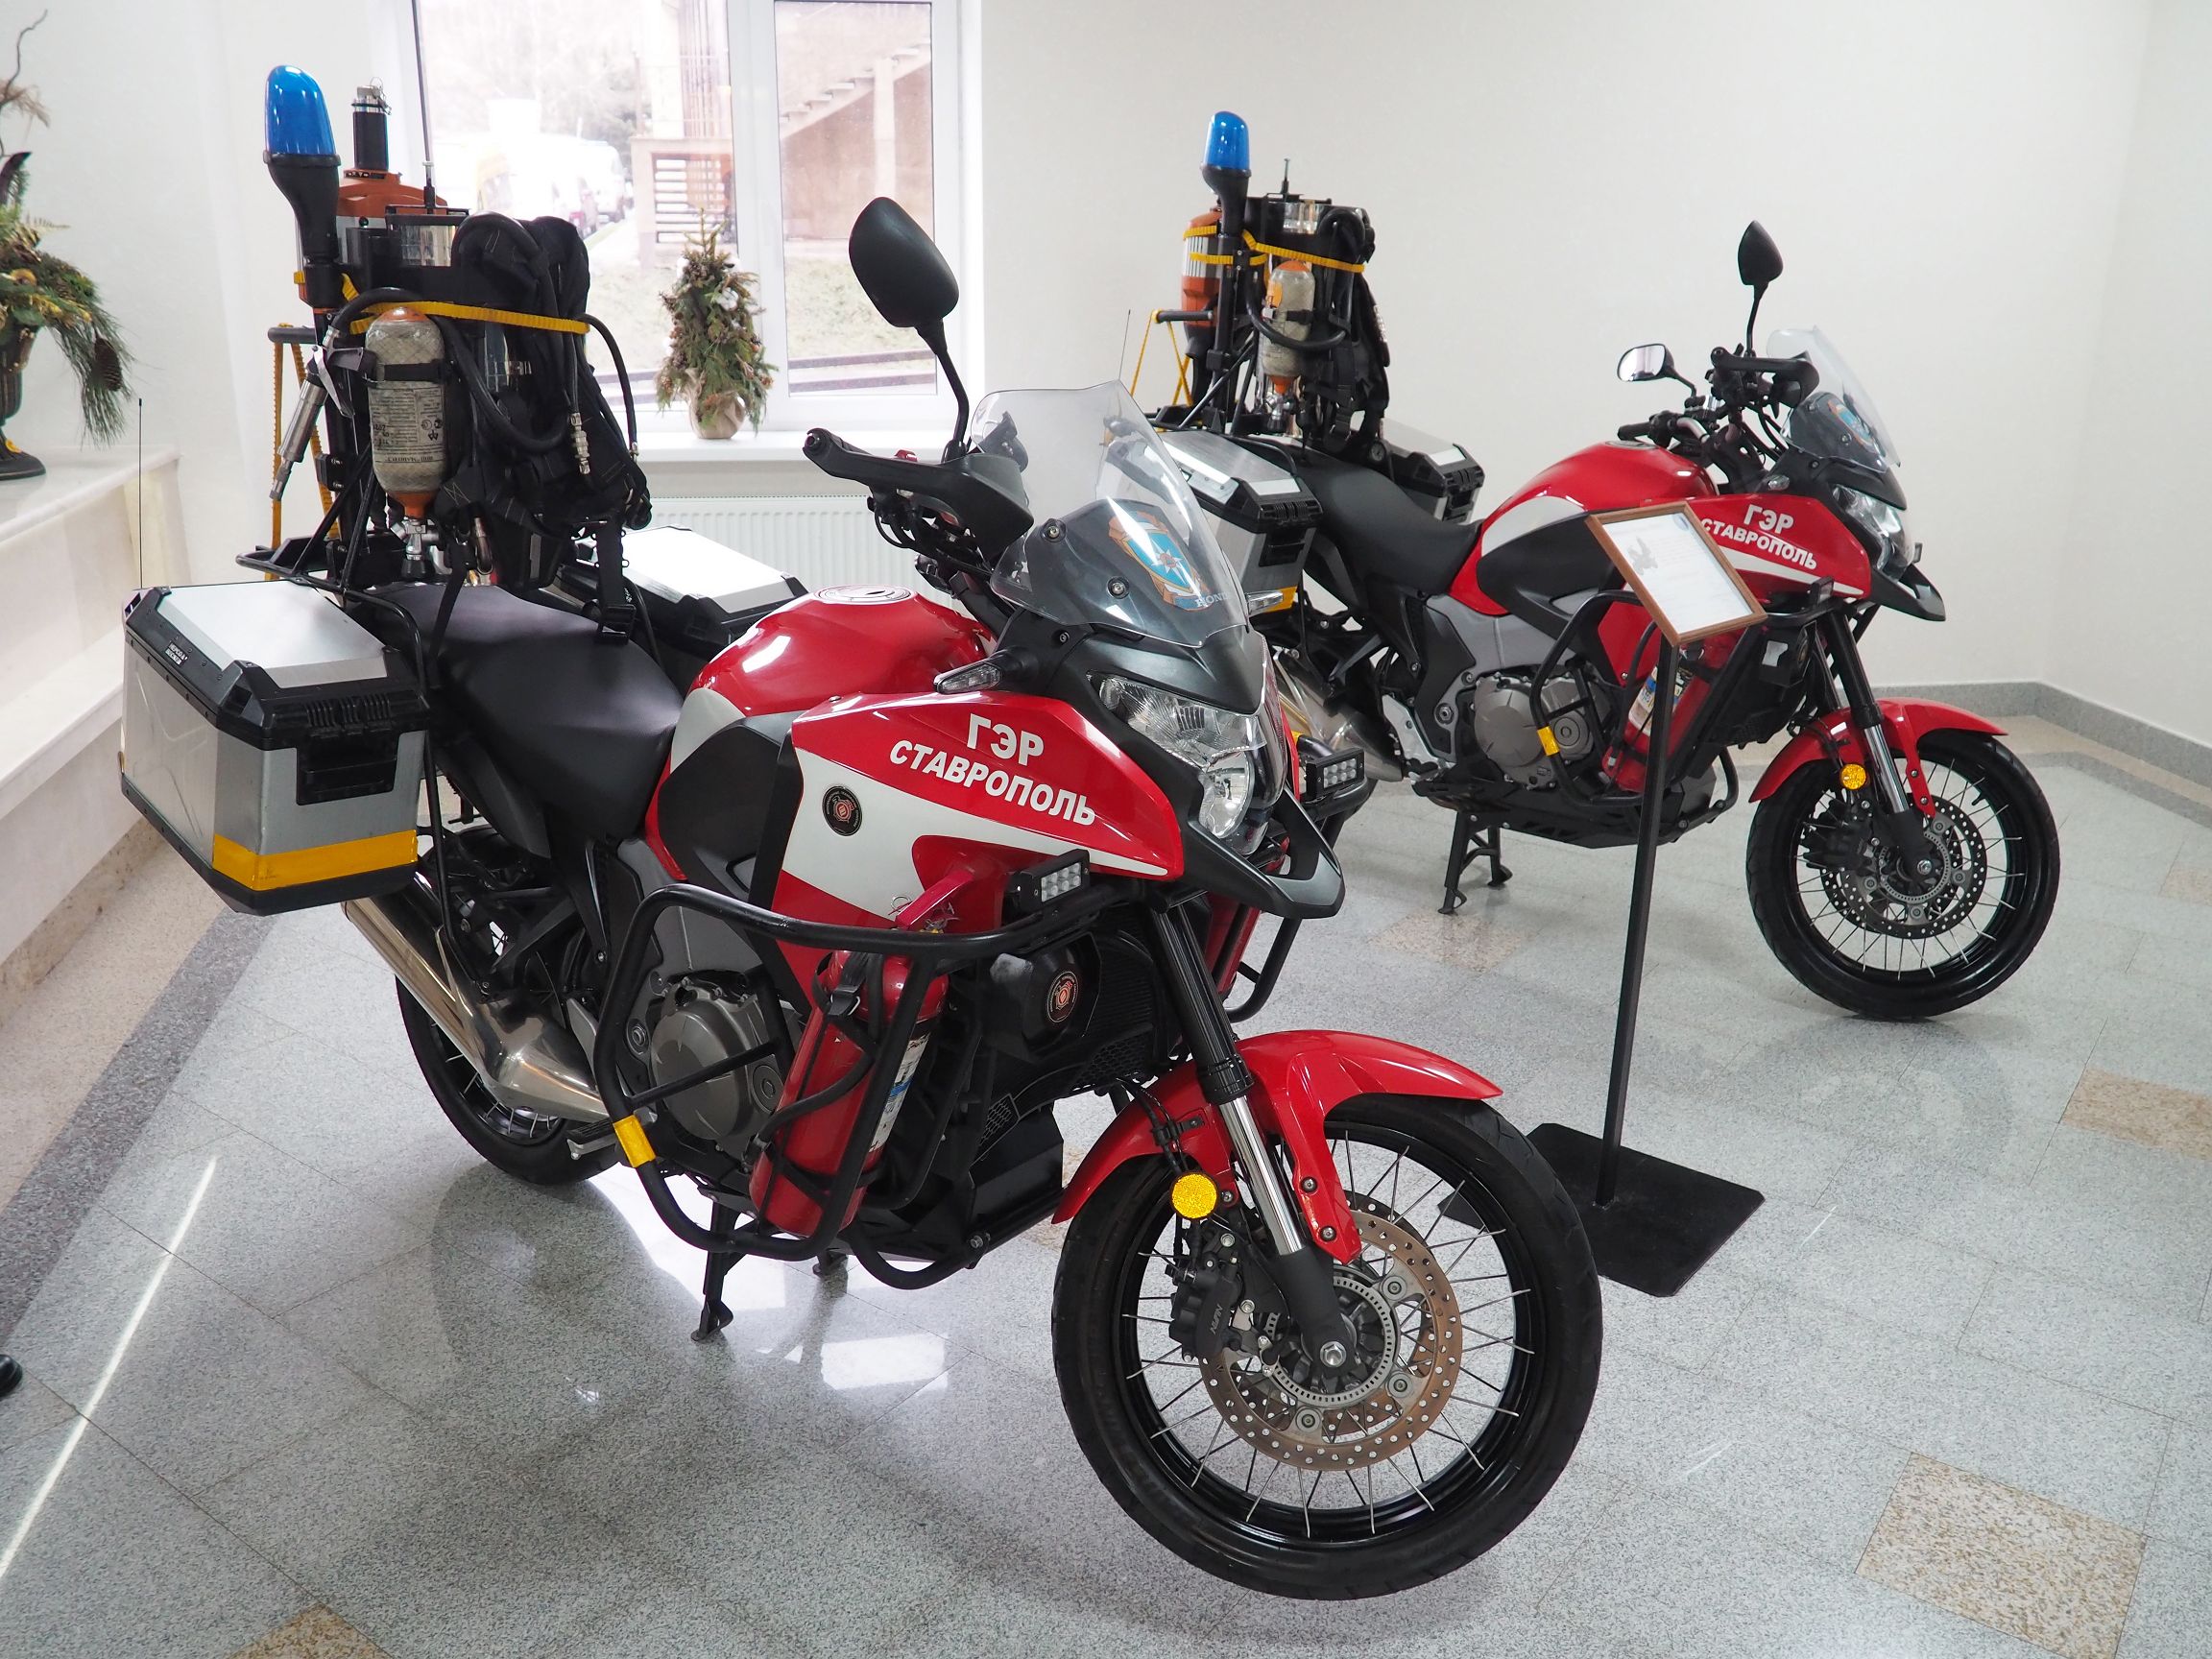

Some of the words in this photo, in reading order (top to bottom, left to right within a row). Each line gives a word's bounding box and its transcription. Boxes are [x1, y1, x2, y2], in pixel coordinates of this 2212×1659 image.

[1701, 517, 1817, 570] СТАВРОПОЛЬ
[1743, 504, 1794, 534] ГЭР
[1195, 592, 1232, 608] HOND
[966, 712, 1045, 766] ГЭР
[889, 738, 1096, 826] СТАВРОПОЛЬ
